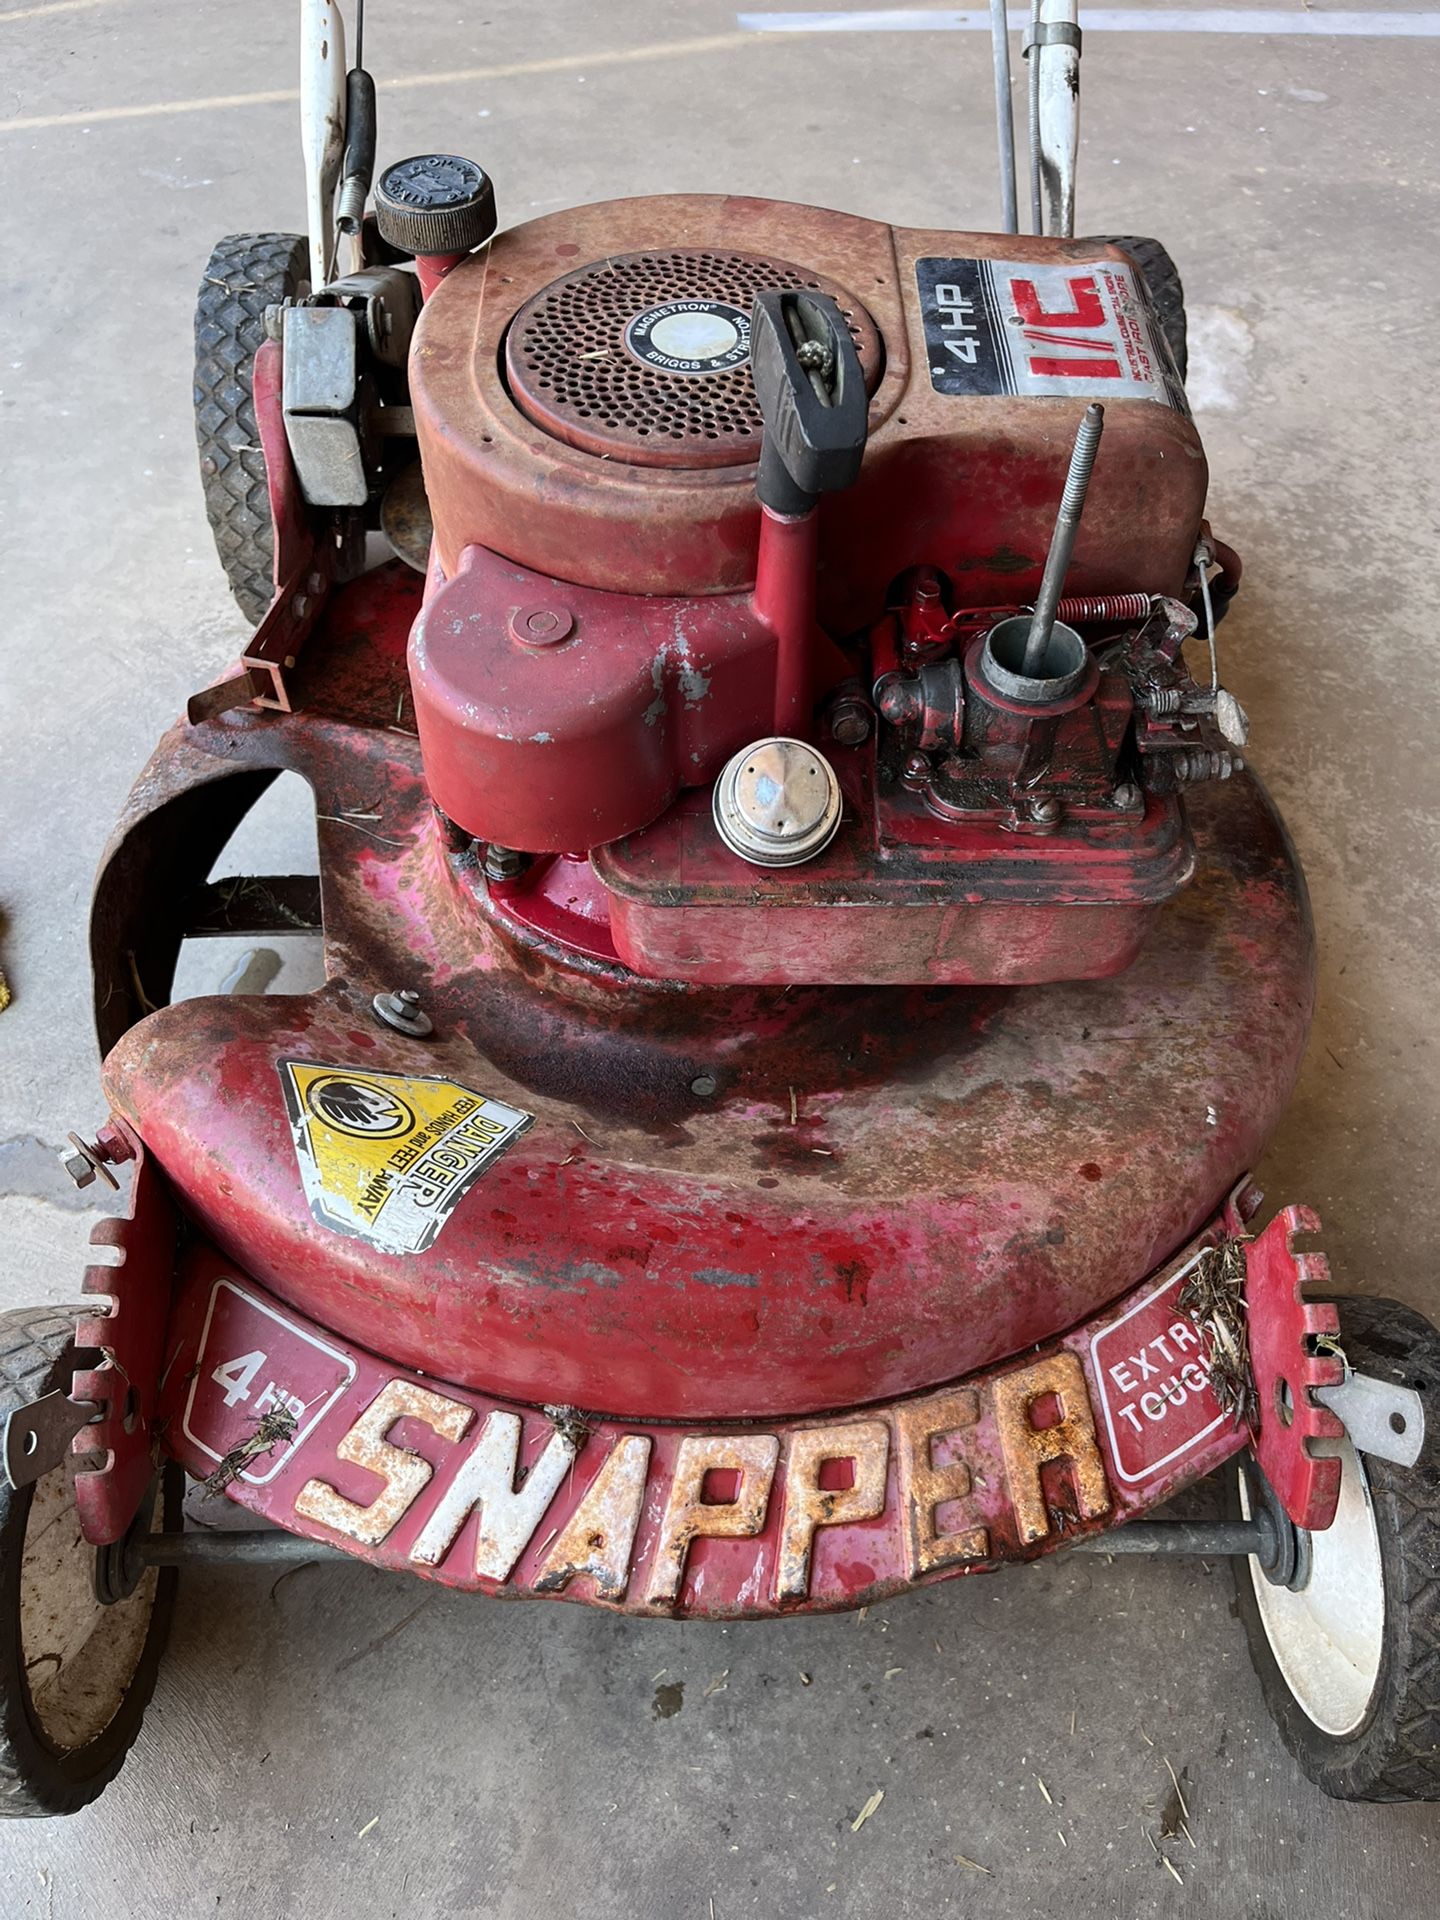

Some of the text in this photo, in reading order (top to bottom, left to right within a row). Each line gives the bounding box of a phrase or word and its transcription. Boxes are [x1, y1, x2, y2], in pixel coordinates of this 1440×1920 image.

[646, 351, 702, 370] BRIGGS
[710, 359, 721, 368] &
[935, 284, 980, 364] 4 HP
[357, 1096, 479, 1217] KEEP HANDS and FEET AWAY
[397, 1115, 508, 1208] DANGER
[211, 1350, 267, 1408] 4
[294, 1352, 1113, 1602] SNAPPER
